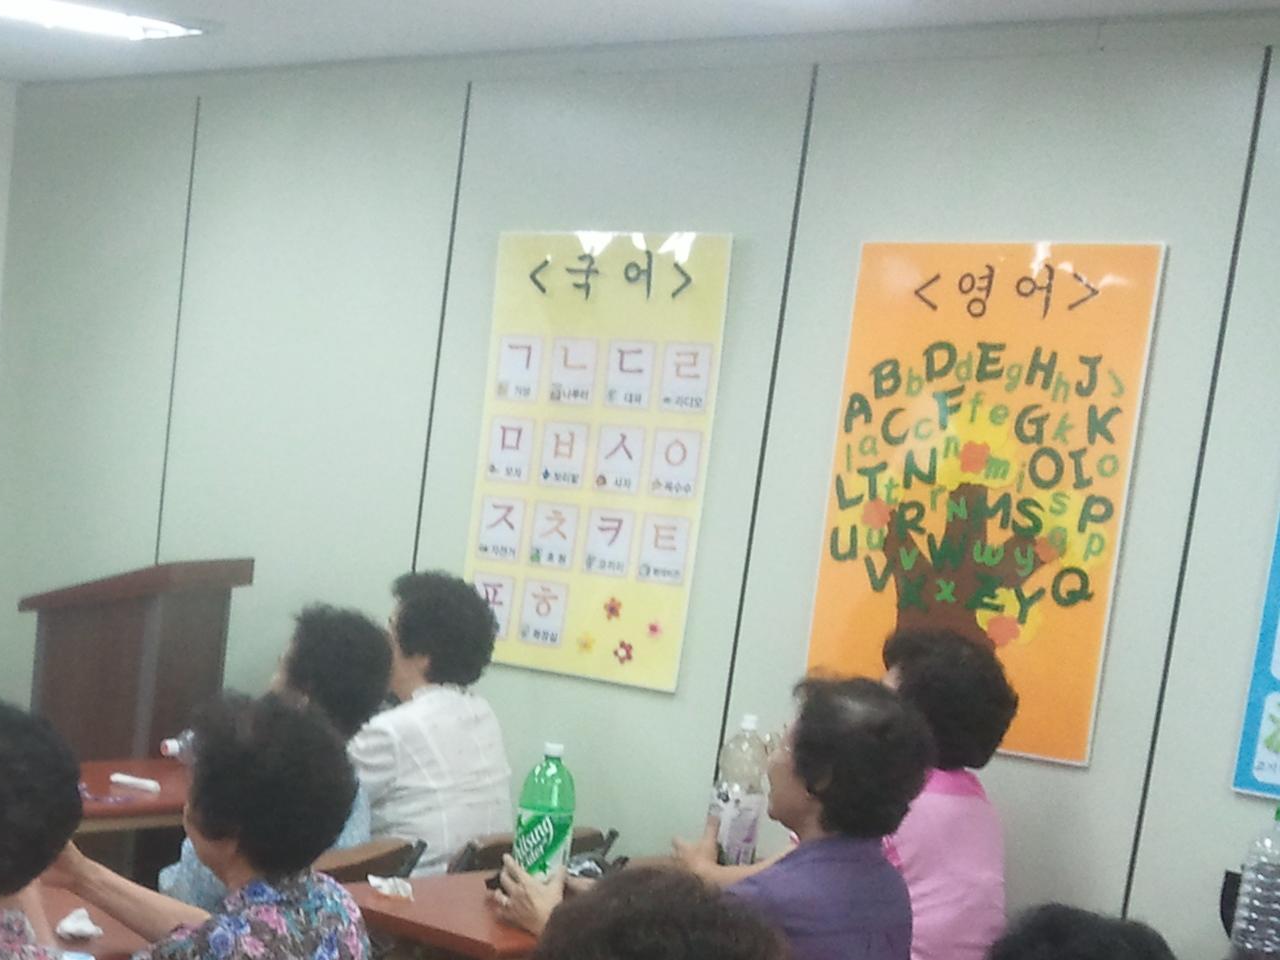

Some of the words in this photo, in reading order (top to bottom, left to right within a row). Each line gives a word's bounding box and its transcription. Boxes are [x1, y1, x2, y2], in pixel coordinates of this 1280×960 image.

[870, 359, 902, 399] B
[923, 341, 957, 382] D
[976, 342, 1006, 382] E
[1025, 346, 1057, 390] H
[1075, 354, 1102, 397] J
[844, 392, 872, 433] A
[1014, 404, 1050, 445] G
[903, 447, 937, 488] N
[1052, 567, 1094, 607] Q
